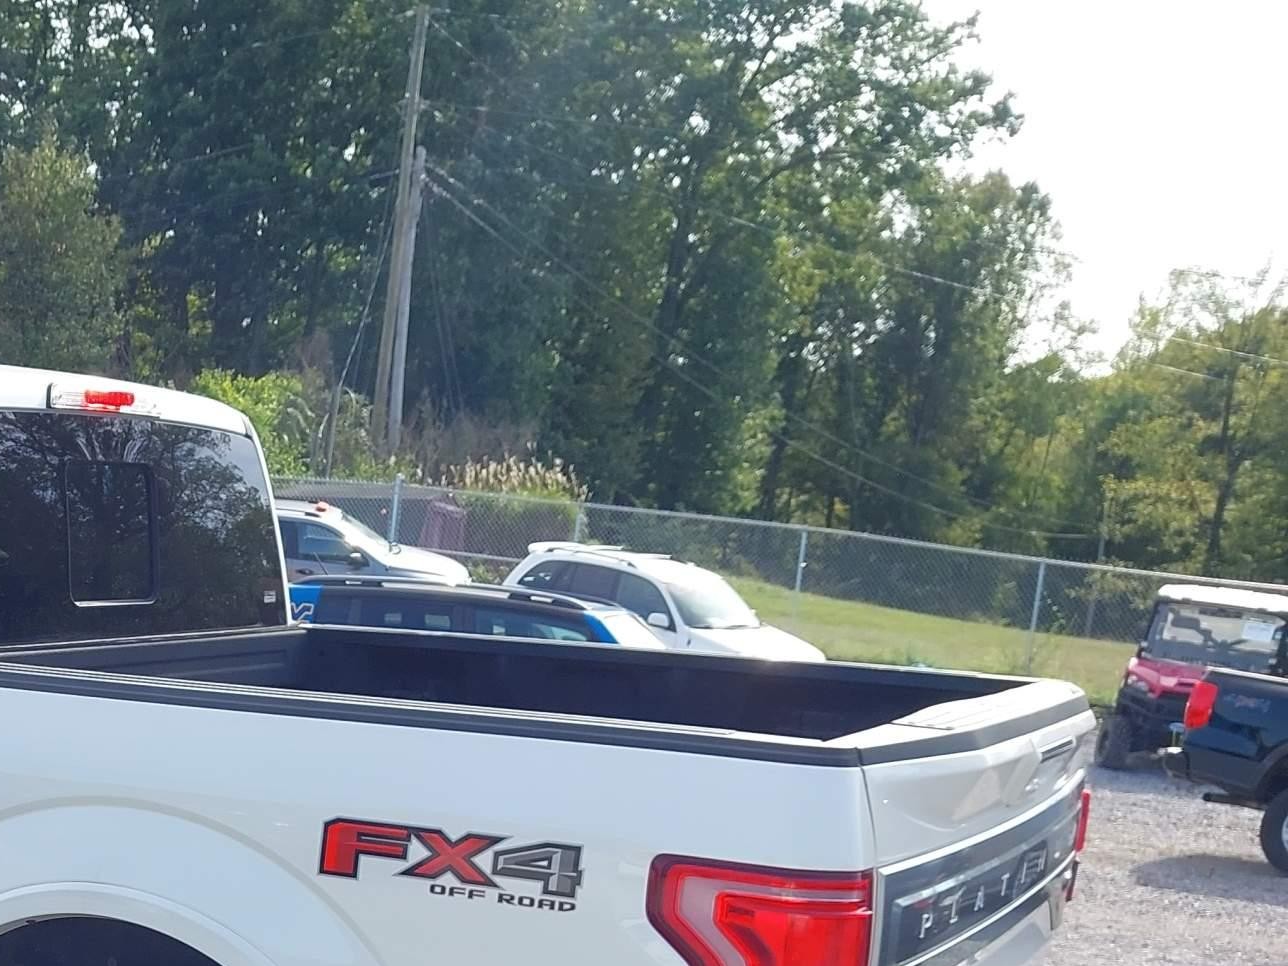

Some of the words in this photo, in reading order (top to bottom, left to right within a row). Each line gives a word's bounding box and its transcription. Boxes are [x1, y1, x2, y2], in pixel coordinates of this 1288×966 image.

[317, 815, 585, 900] FX4
[428, 883, 486, 900] OFF
[496, 891, 577, 913] ROAD
